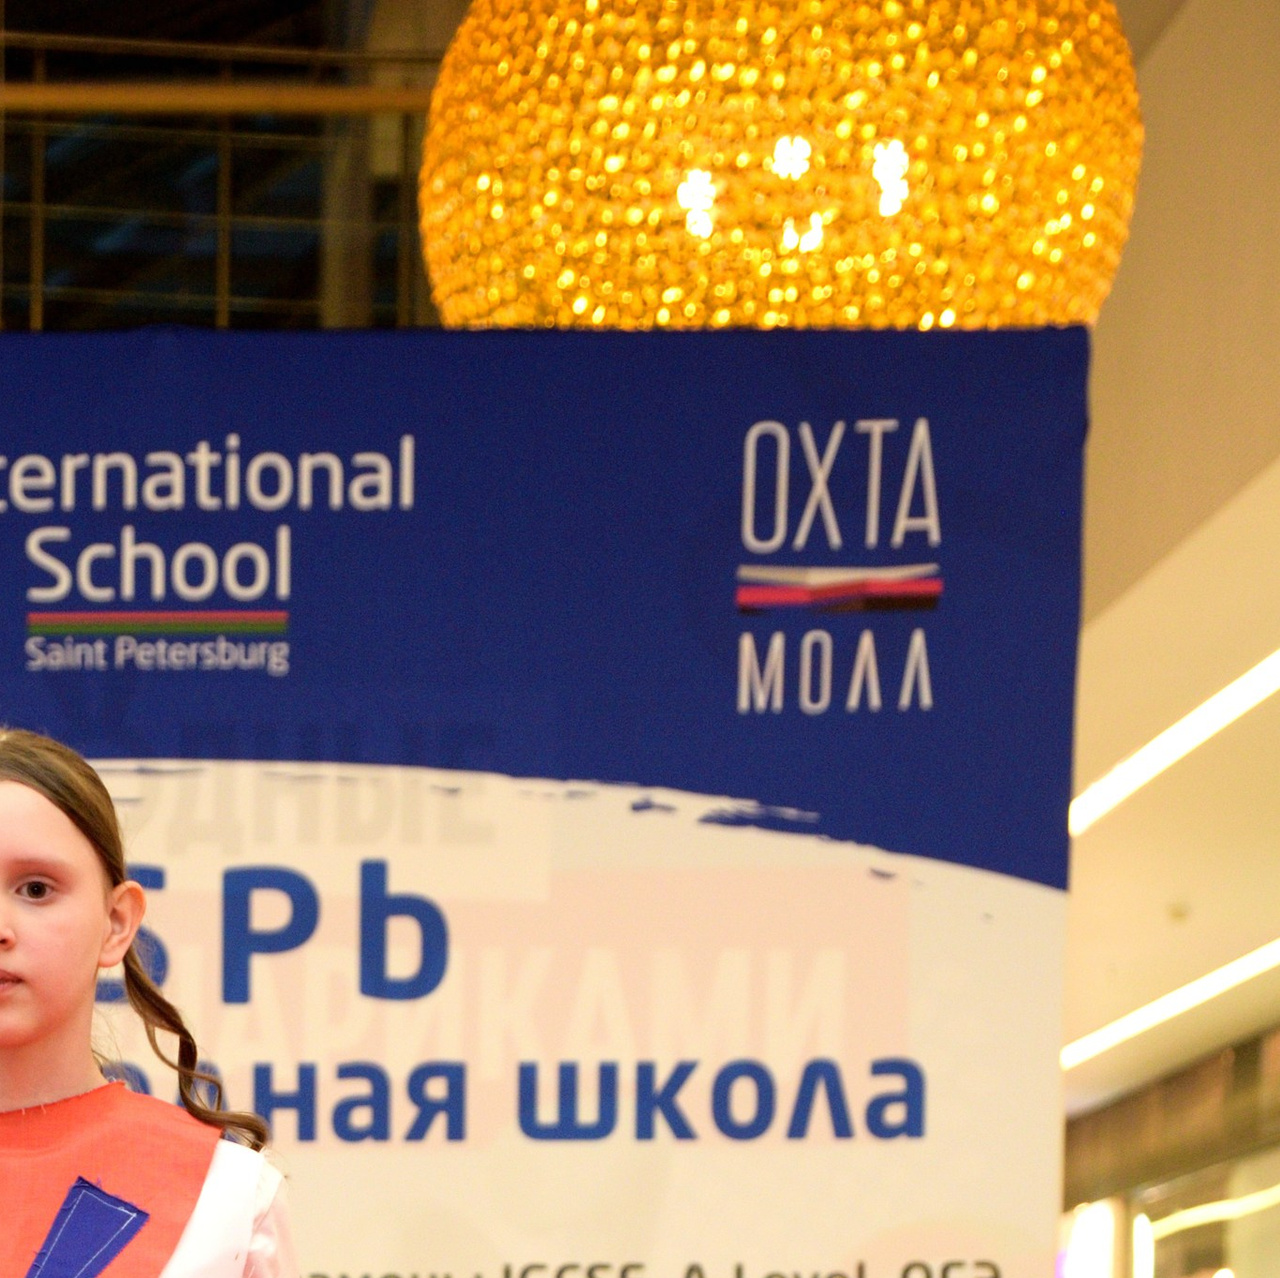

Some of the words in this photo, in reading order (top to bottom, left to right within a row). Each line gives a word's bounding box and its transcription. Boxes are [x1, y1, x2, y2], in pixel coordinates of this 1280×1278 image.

[741, 418, 941, 553] ОХТА
[26, 525, 291, 602] School
[25, 636, 107, 672] Saint
[115, 634, 290, 677] Petersburg
[737, 628, 933, 714] МОЛЛ
[518, 1057, 926, 1142] школа
